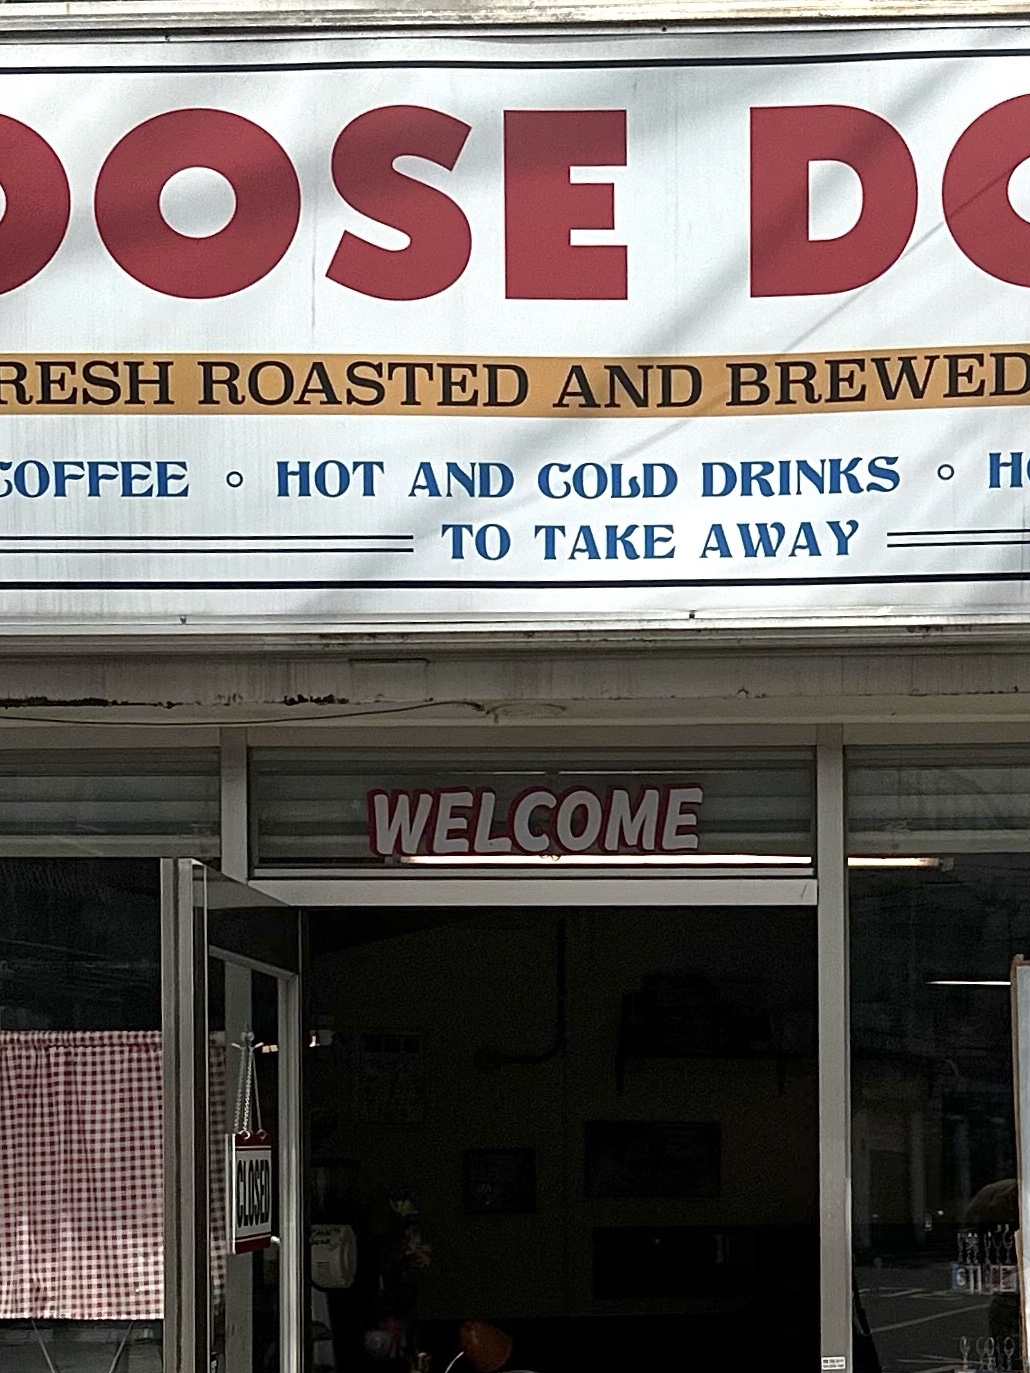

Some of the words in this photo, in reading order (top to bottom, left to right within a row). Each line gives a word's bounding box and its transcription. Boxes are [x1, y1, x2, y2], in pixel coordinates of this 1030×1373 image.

[0, 361, 174, 405] RESH
[200, 361, 528, 407] ROASTED
[553, 365, 702, 408] AND
[277, 460, 384, 497] HOT
[408, 462, 514, 497] AND
[538, 463, 677, 499] COLD
[702, 456, 900, 497] DRINKS
[442, 524, 510, 560] TO
[535, 525, 675, 560] TAKE
[700, 520, 858, 558] AWAY
[368, 784, 703, 854] WELCOME
[237, 1160, 269, 1228] CLOSED
